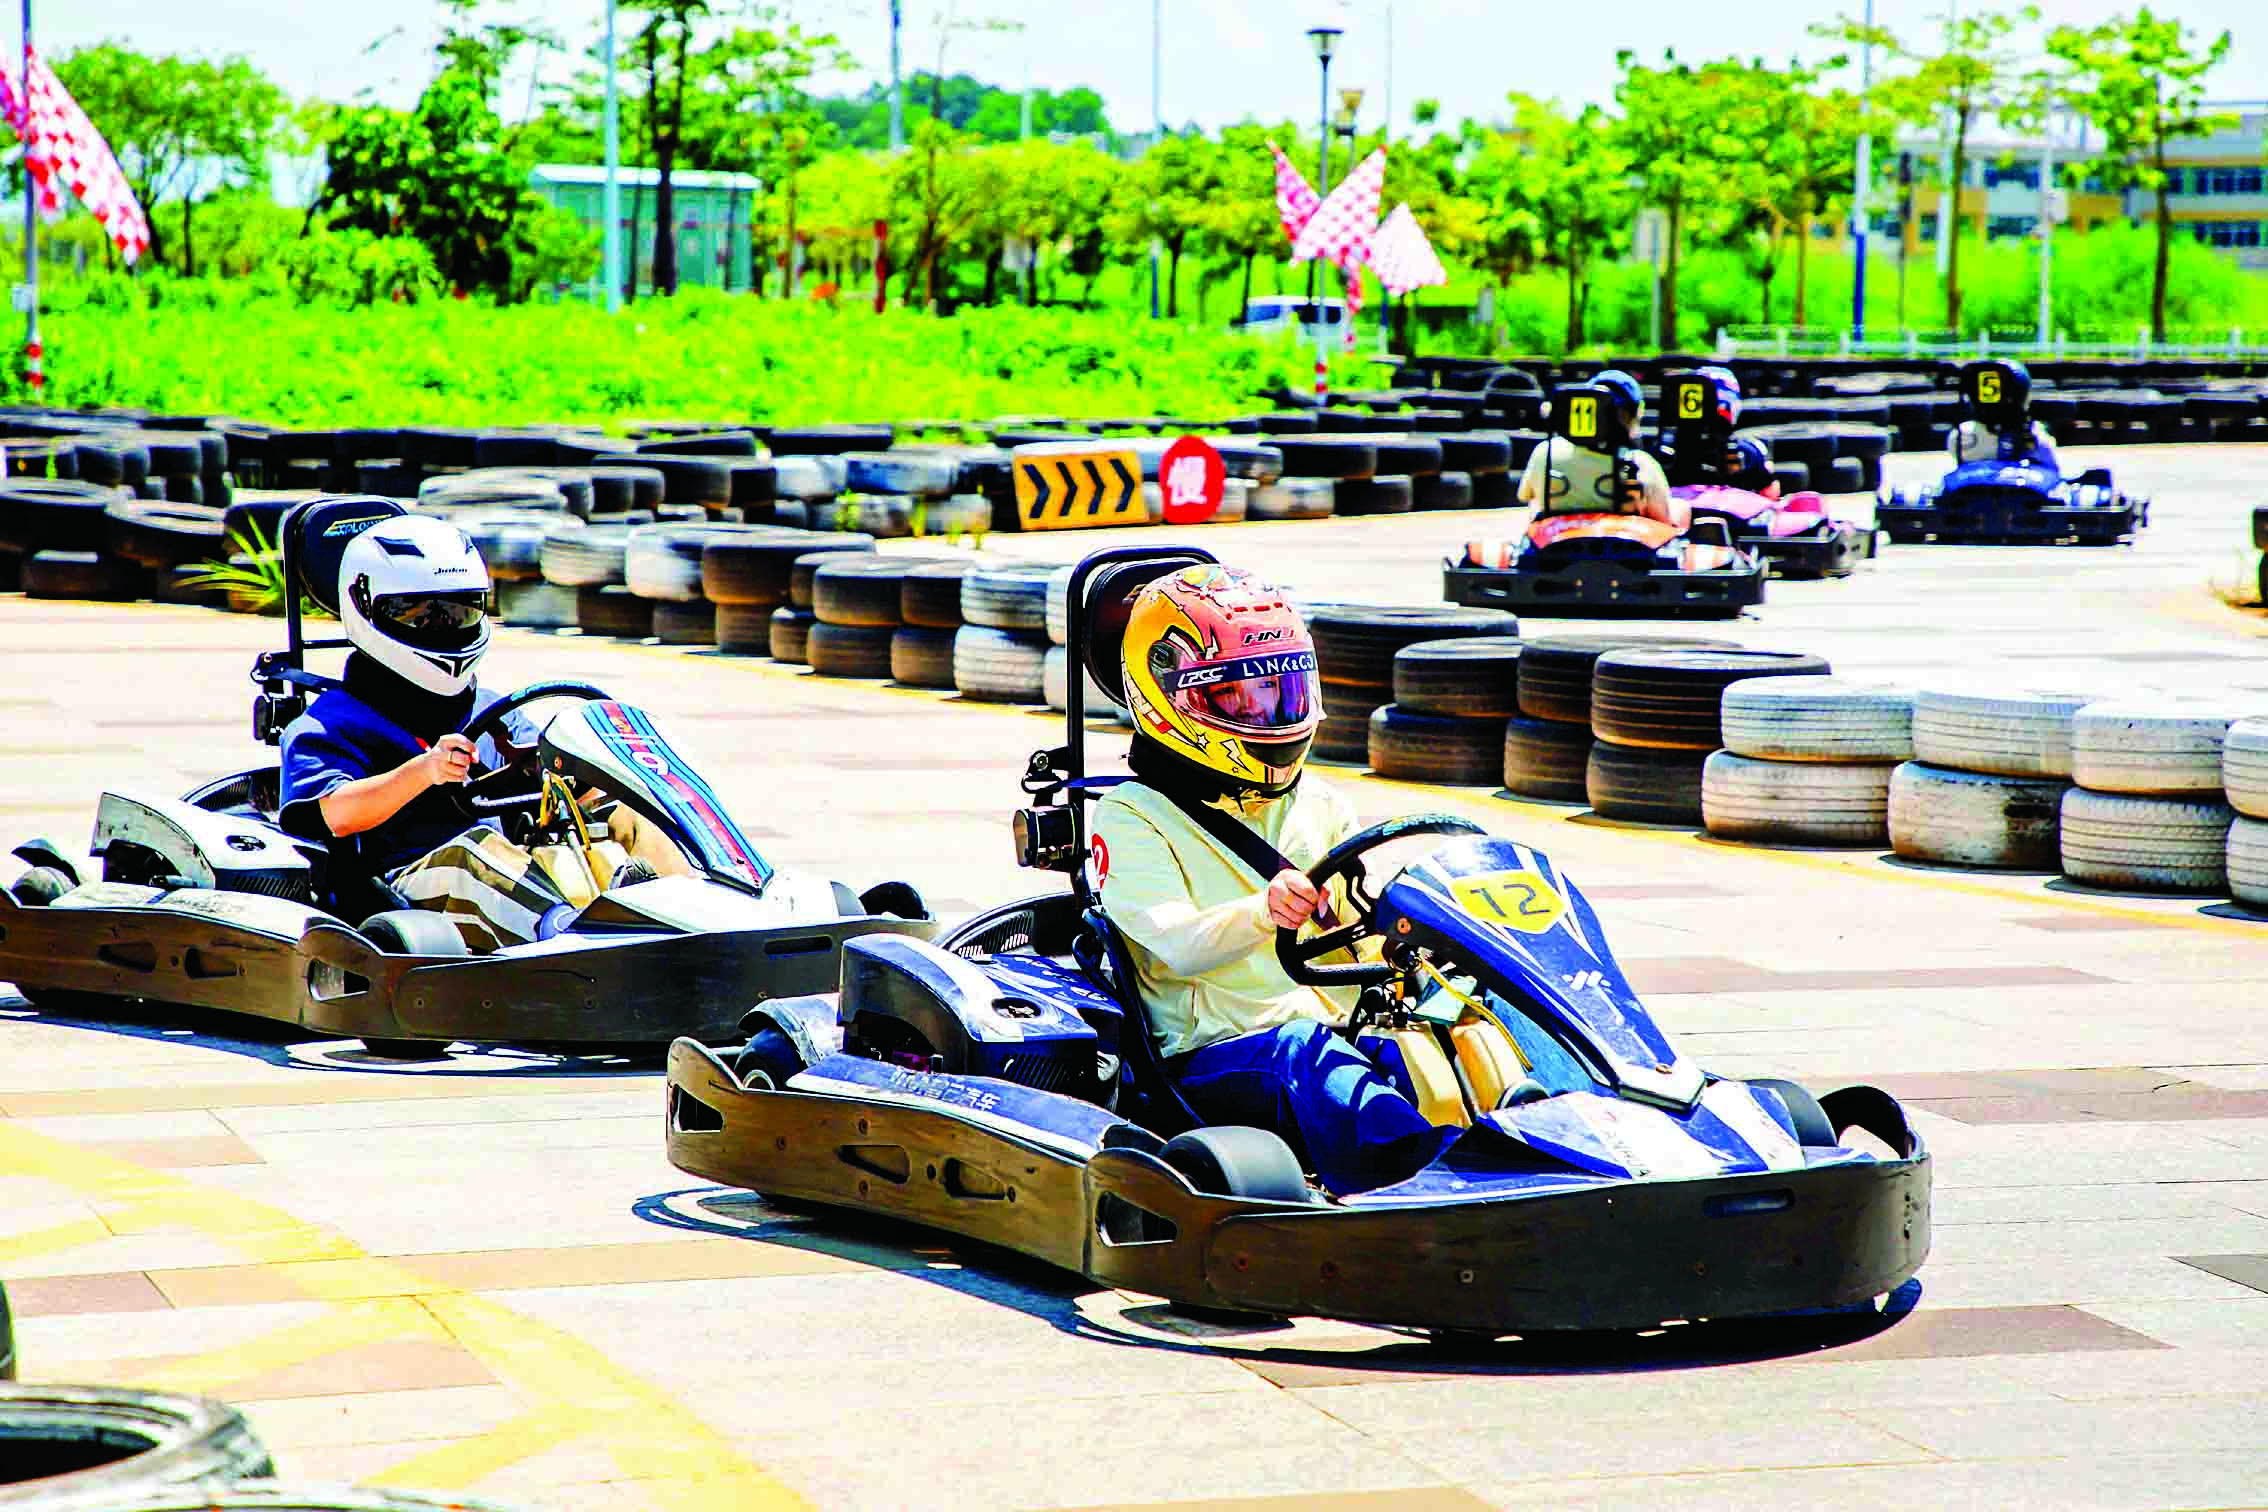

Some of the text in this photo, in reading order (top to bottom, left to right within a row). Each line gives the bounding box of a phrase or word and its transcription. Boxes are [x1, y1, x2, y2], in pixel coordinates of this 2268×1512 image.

[1983, 375, 1999, 397] 5
[1683, 388, 1701, 413] 6
[1574, 403, 1593, 433] 11
[1469, 883, 1552, 918] 12
